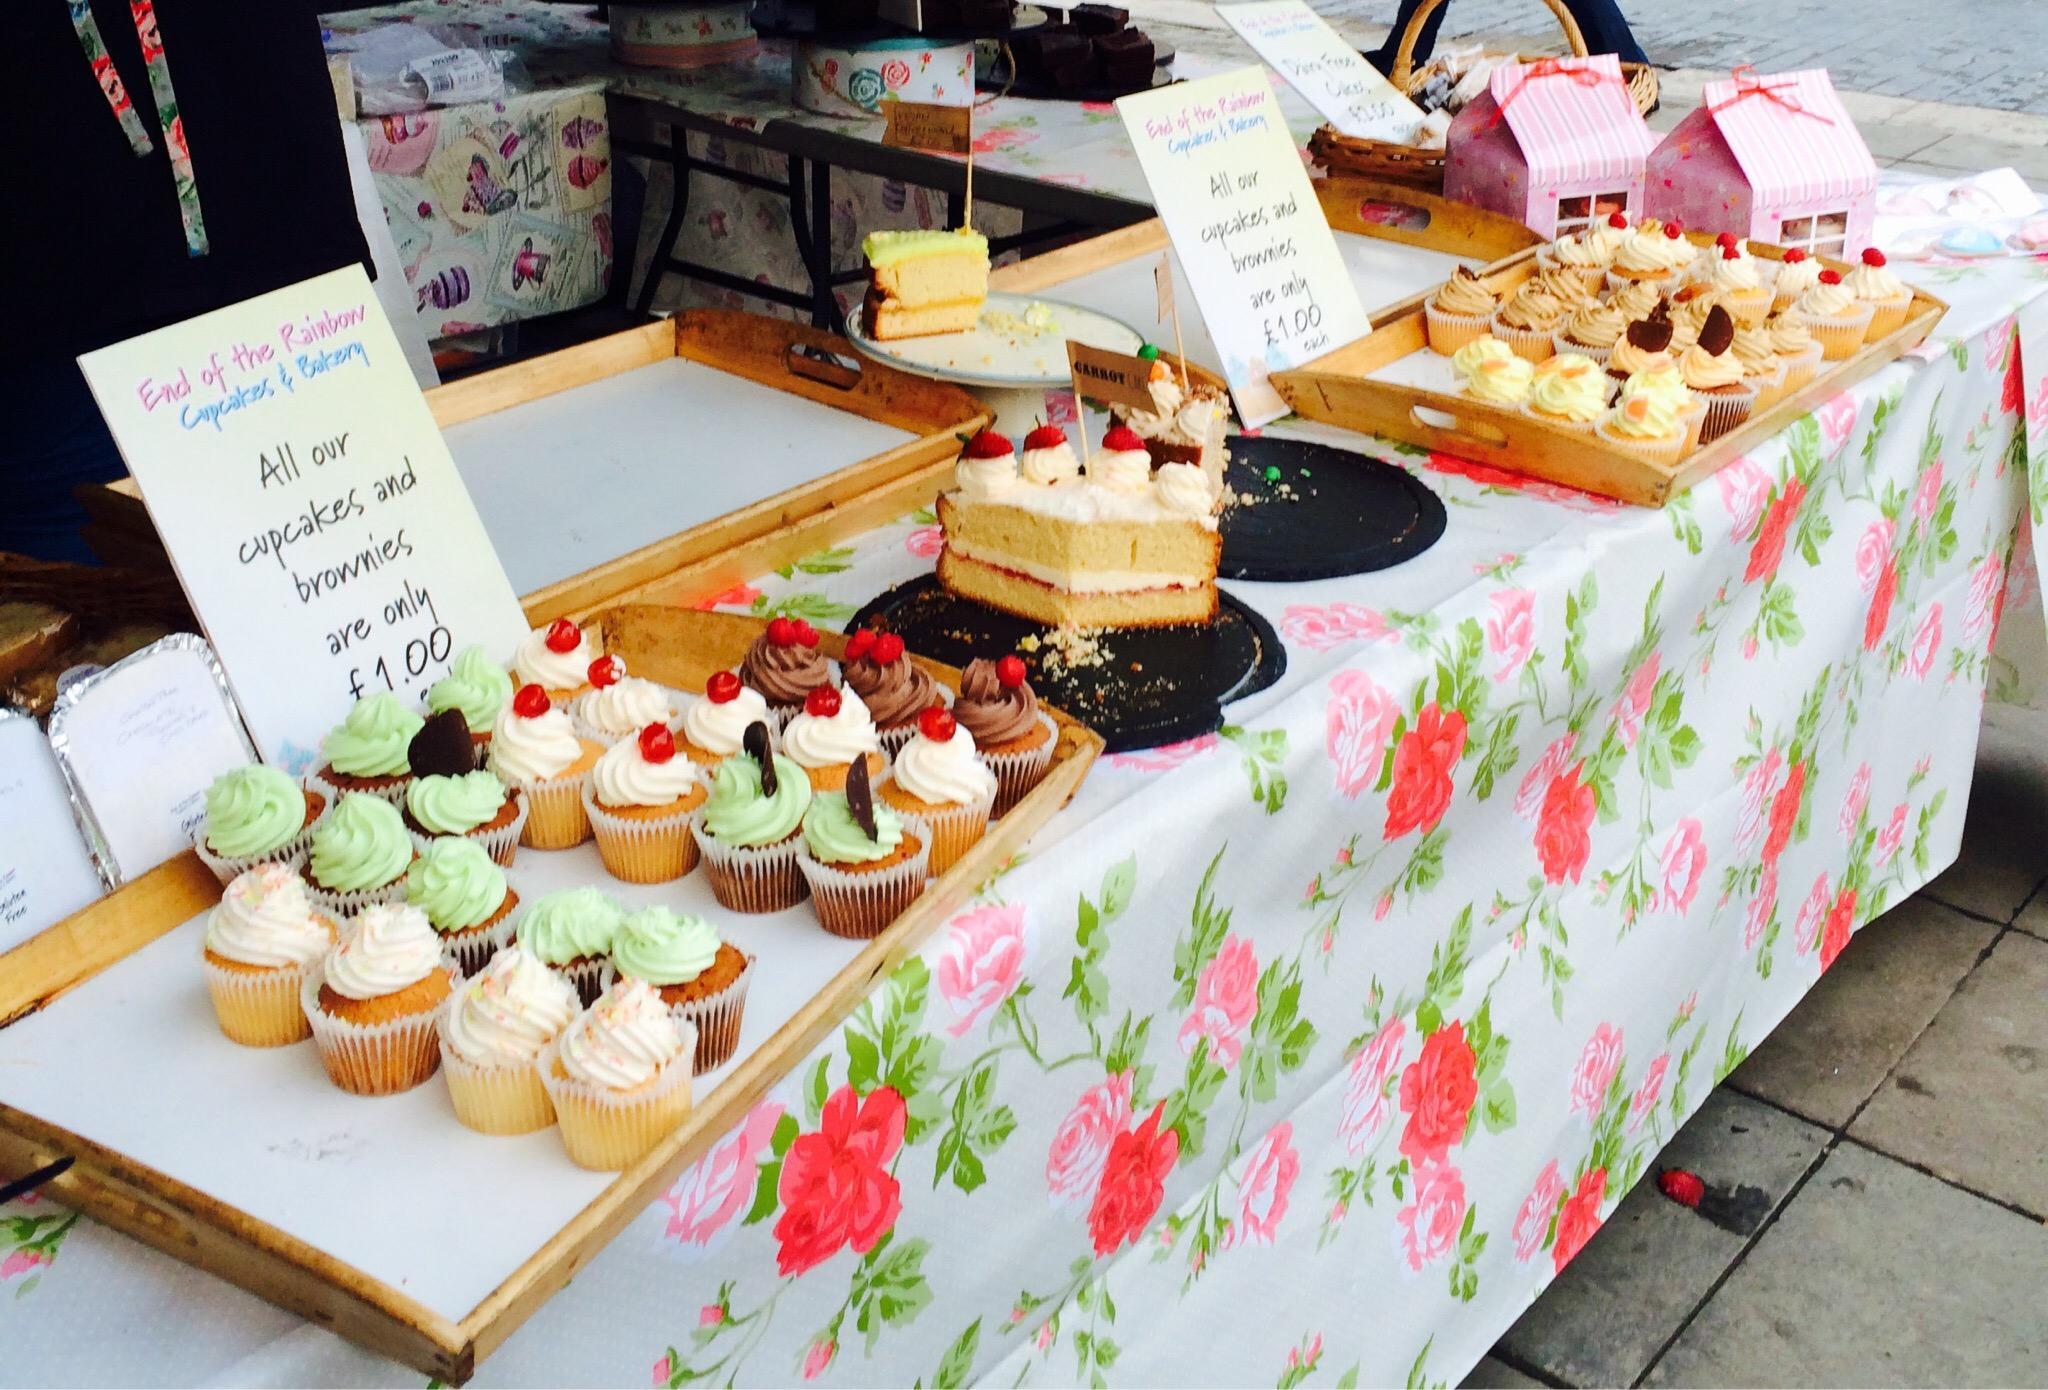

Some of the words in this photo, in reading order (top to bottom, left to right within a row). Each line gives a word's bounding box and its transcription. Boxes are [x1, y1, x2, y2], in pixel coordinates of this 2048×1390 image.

[1146, 115, 1173, 139] End
[1178, 108, 1191, 134] of
[1194, 104, 1216, 122] the
[1210, 171, 1232, 199] All
[1238, 170, 1258, 190] our
[1201, 205, 1268, 251] cupcakes
[1272, 191, 1297, 219] and
[1231, 236, 1297, 275] brownies
[1250, 287, 1275, 310] are
[1281, 270, 1314, 304] only
[1264, 303, 1322, 347] £1.00
[1304, 330, 1330, 351] each
[137, 366, 191, 412] End
[200, 351, 227, 394] of
[231, 341, 275, 373] the
[277, 303, 366, 353] Rainbow
[1073, 360, 1126, 386] CARROT
[178, 377, 275, 433] Cupcakes
[295, 341, 371, 380] Bakery
[259, 442, 301, 489] All
[311, 431, 350, 467] our
[238, 487, 365, 571] cupcakes
[372, 454, 417, 503] and
[291, 527, 414, 604] brownies
[325, 617, 372, 656] are
[383, 579, 439, 626] only
[348, 626, 452, 702] £1.00
